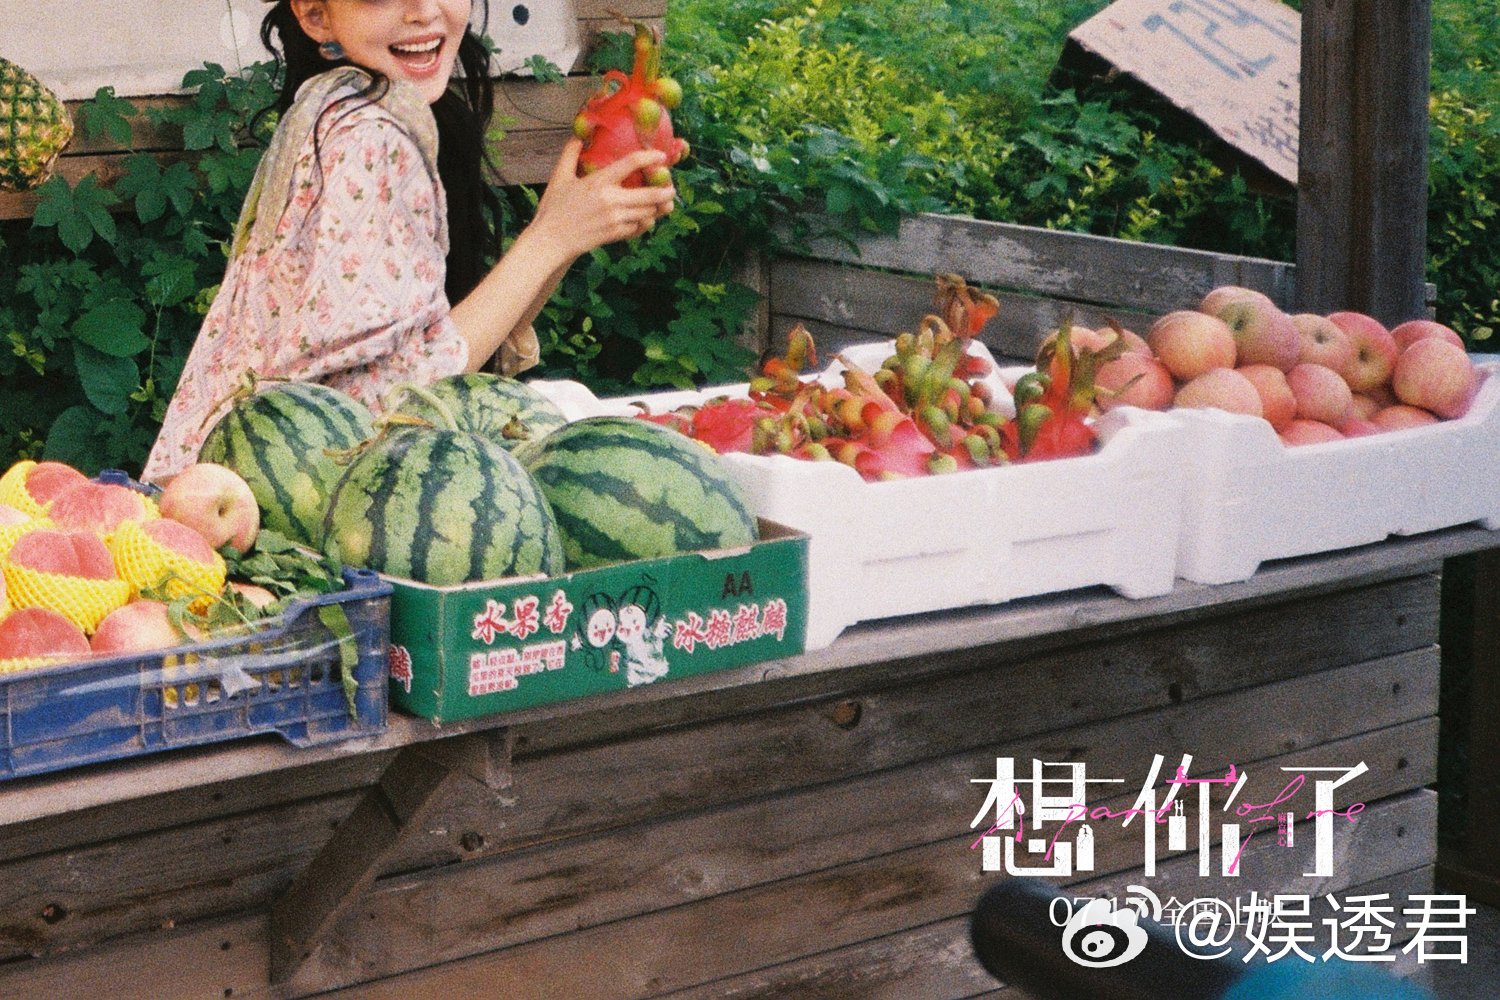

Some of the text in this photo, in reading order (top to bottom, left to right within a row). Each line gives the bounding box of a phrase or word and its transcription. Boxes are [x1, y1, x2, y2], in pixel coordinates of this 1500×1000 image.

[722, 570, 754, 599] AA
[472, 589, 574, 645] 水果香
[673, 598, 788, 653] 冰糖麒麟
